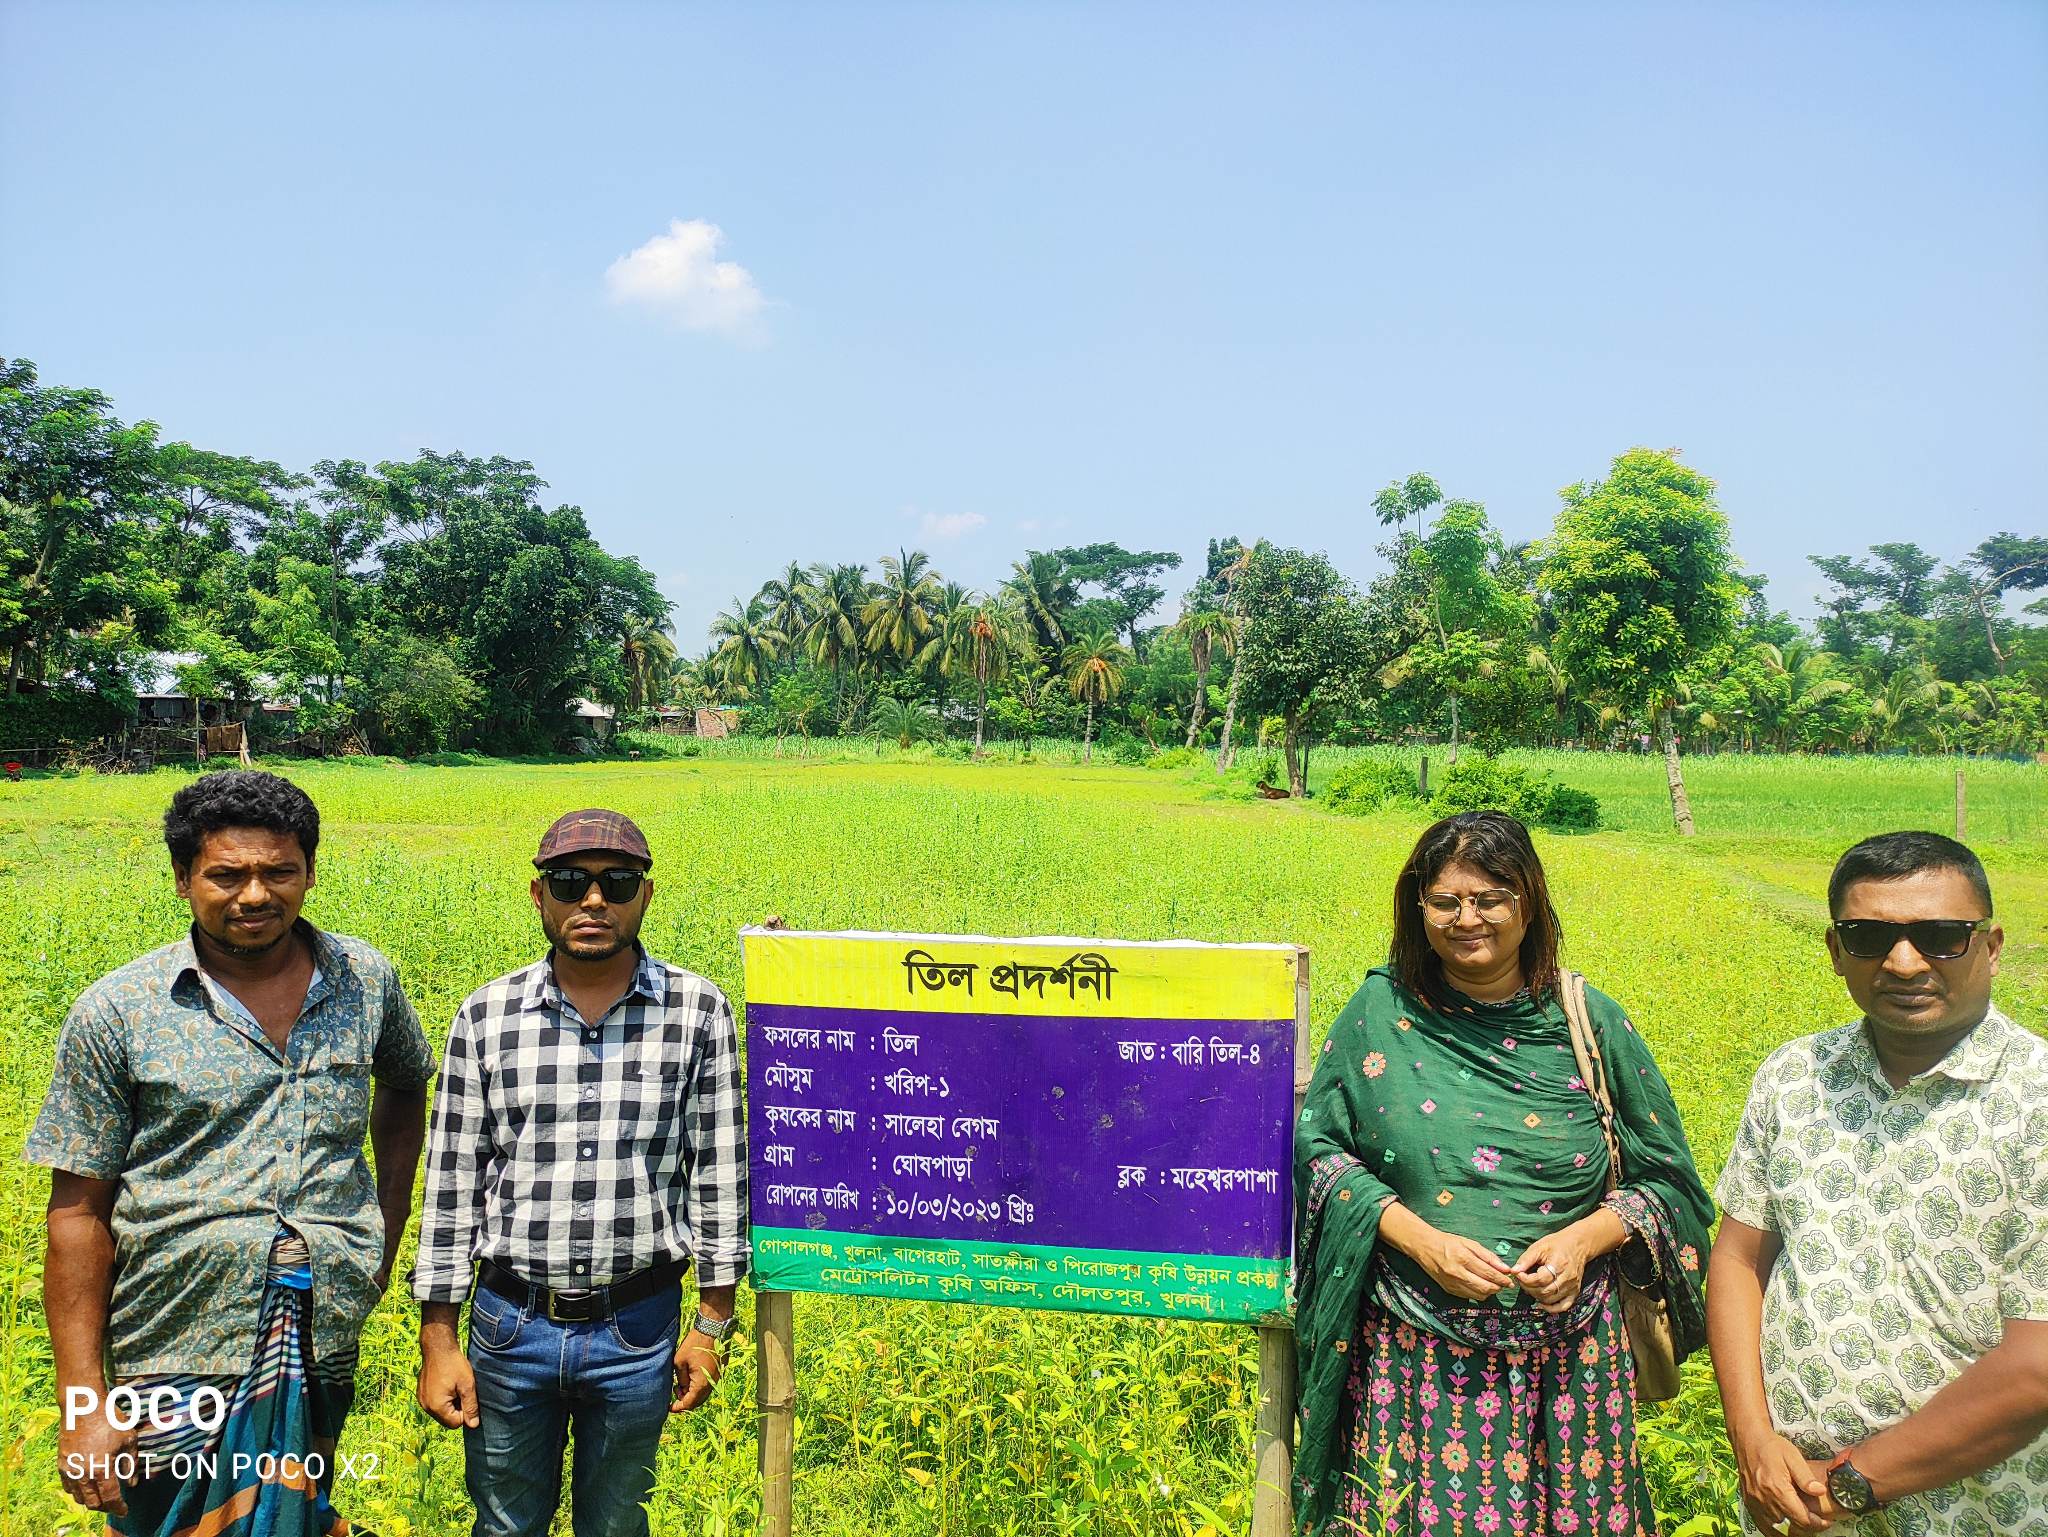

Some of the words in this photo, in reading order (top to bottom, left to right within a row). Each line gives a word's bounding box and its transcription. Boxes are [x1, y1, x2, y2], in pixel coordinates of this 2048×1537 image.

[901, 949, 980, 998] তিল
[989, 952, 1119, 1001] প্রদর্শনী
[763, 1026, 822, 1050] ফসলের
[825, 1028, 856, 1052] নাম
[882, 1026, 921, 1056] তিল
[1117, 1039, 1157, 1064] জাত
[1171, 1036, 1204, 1066] বারি
[1208, 1036, 1261, 1066] তিল-৪
[765, 1059, 814, 1094] মৌসুম
[884, 1067, 950, 1098] খরিপ-১
[764, 1105, 822, 1136] কৃষকের
[826, 1107, 856, 1132] নাম
[883, 1113, 945, 1140] সালেহা
[951, 1116, 1000, 1140] বেগম
[764, 1142, 795, 1167] গ্রাম
[892, 1152, 973, 1182] ঘোষপাড়া
[1116, 1165, 1147, 1189] ব্লক
[1170, 1166, 1278, 1194] মহেশ্বরপাশা
[766, 1182, 818, 1208] রোপনের
[821, 1181, 860, 1210] তারিখ
[886, 1191, 1001, 1222] ১০/০৩/২০২৩
[843, 1245, 887, 1264] খুলনা,
[892, 1243, 966, 1271] বাগেরহাট,
[971, 1251, 1040, 1273] সাতক্ষীরা
[1045, 1259, 1058, 1272] ও
[1063, 1255, 1141, 1283] পিরোজপুর
[1147, 1261, 1179, 1287] কৃষি
[1182, 1262, 1232, 1286] উন্নয়ন
[820, 1266, 929, 1289] মেট্রোপলিটন
[936, 1274, 974, 1297] কৃষি
[979, 1275, 1044, 1300] অফিস,
[1052, 1280, 1151, 1309] দৌলতপুর,
